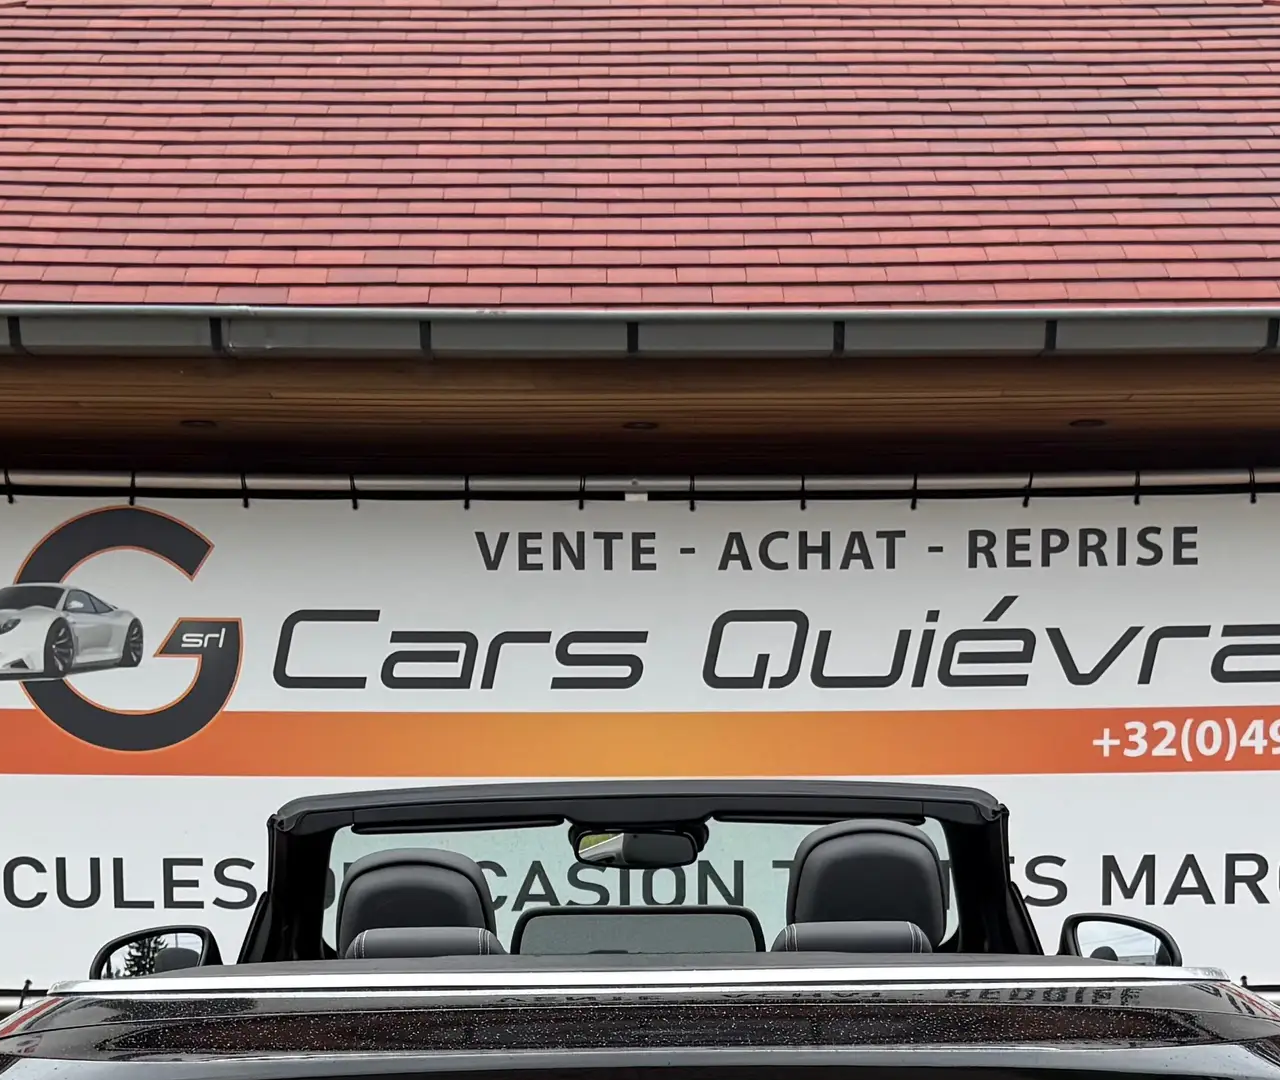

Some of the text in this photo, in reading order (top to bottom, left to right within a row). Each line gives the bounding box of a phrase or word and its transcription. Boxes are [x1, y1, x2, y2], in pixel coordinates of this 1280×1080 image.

[475, 531, 657, 571] VENTE
[718, 530, 907, 570] ACHAT
[968, 525, 1199, 569] REPRISE
[180, 627, 226, 649] srl
[273, 608, 649, 690] Cars
